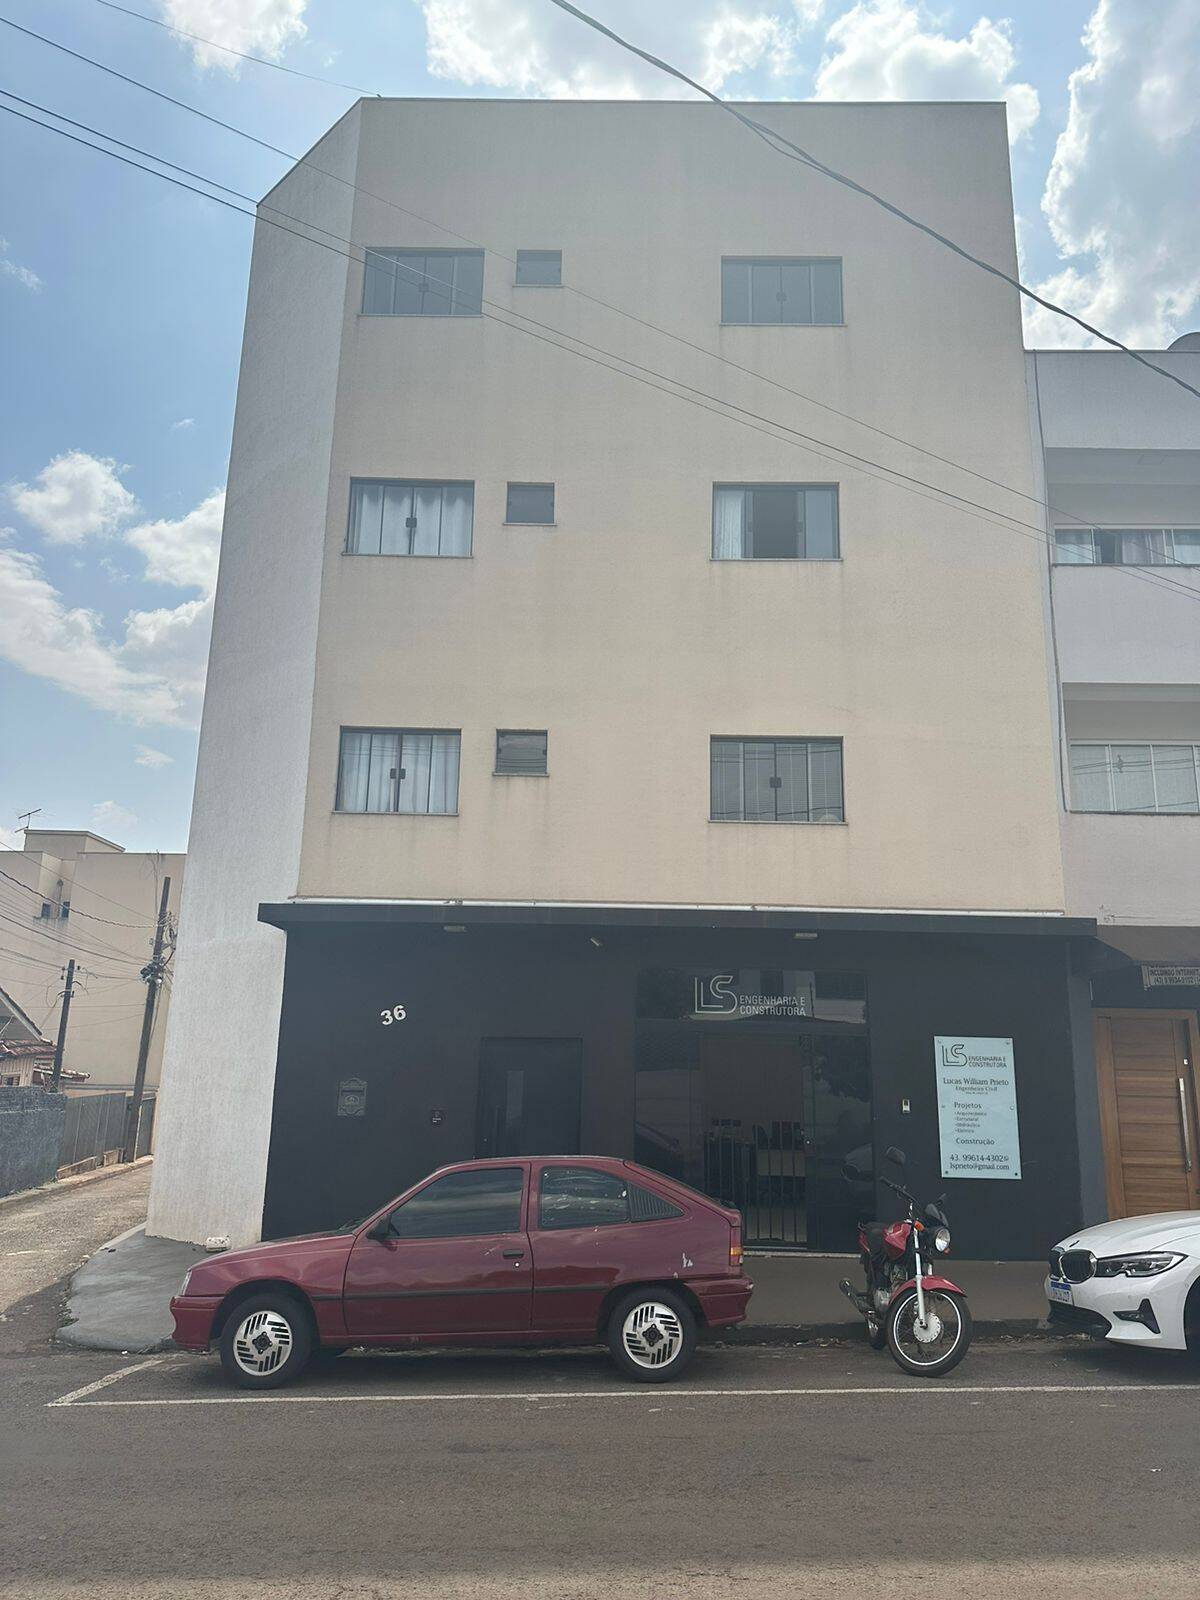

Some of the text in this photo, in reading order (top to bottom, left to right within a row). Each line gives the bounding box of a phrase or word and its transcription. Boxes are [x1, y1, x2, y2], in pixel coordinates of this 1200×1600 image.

[695, 975, 738, 1014] LS
[740, 995, 806, 1007] ENGENHARIA E
[380, 1005, 406, 1025] 36
[740, 1005, 806, 1016] CONSTRUTORA
[942, 1044, 968, 1067] LS
[955, 1138, 995, 1146] Construção
